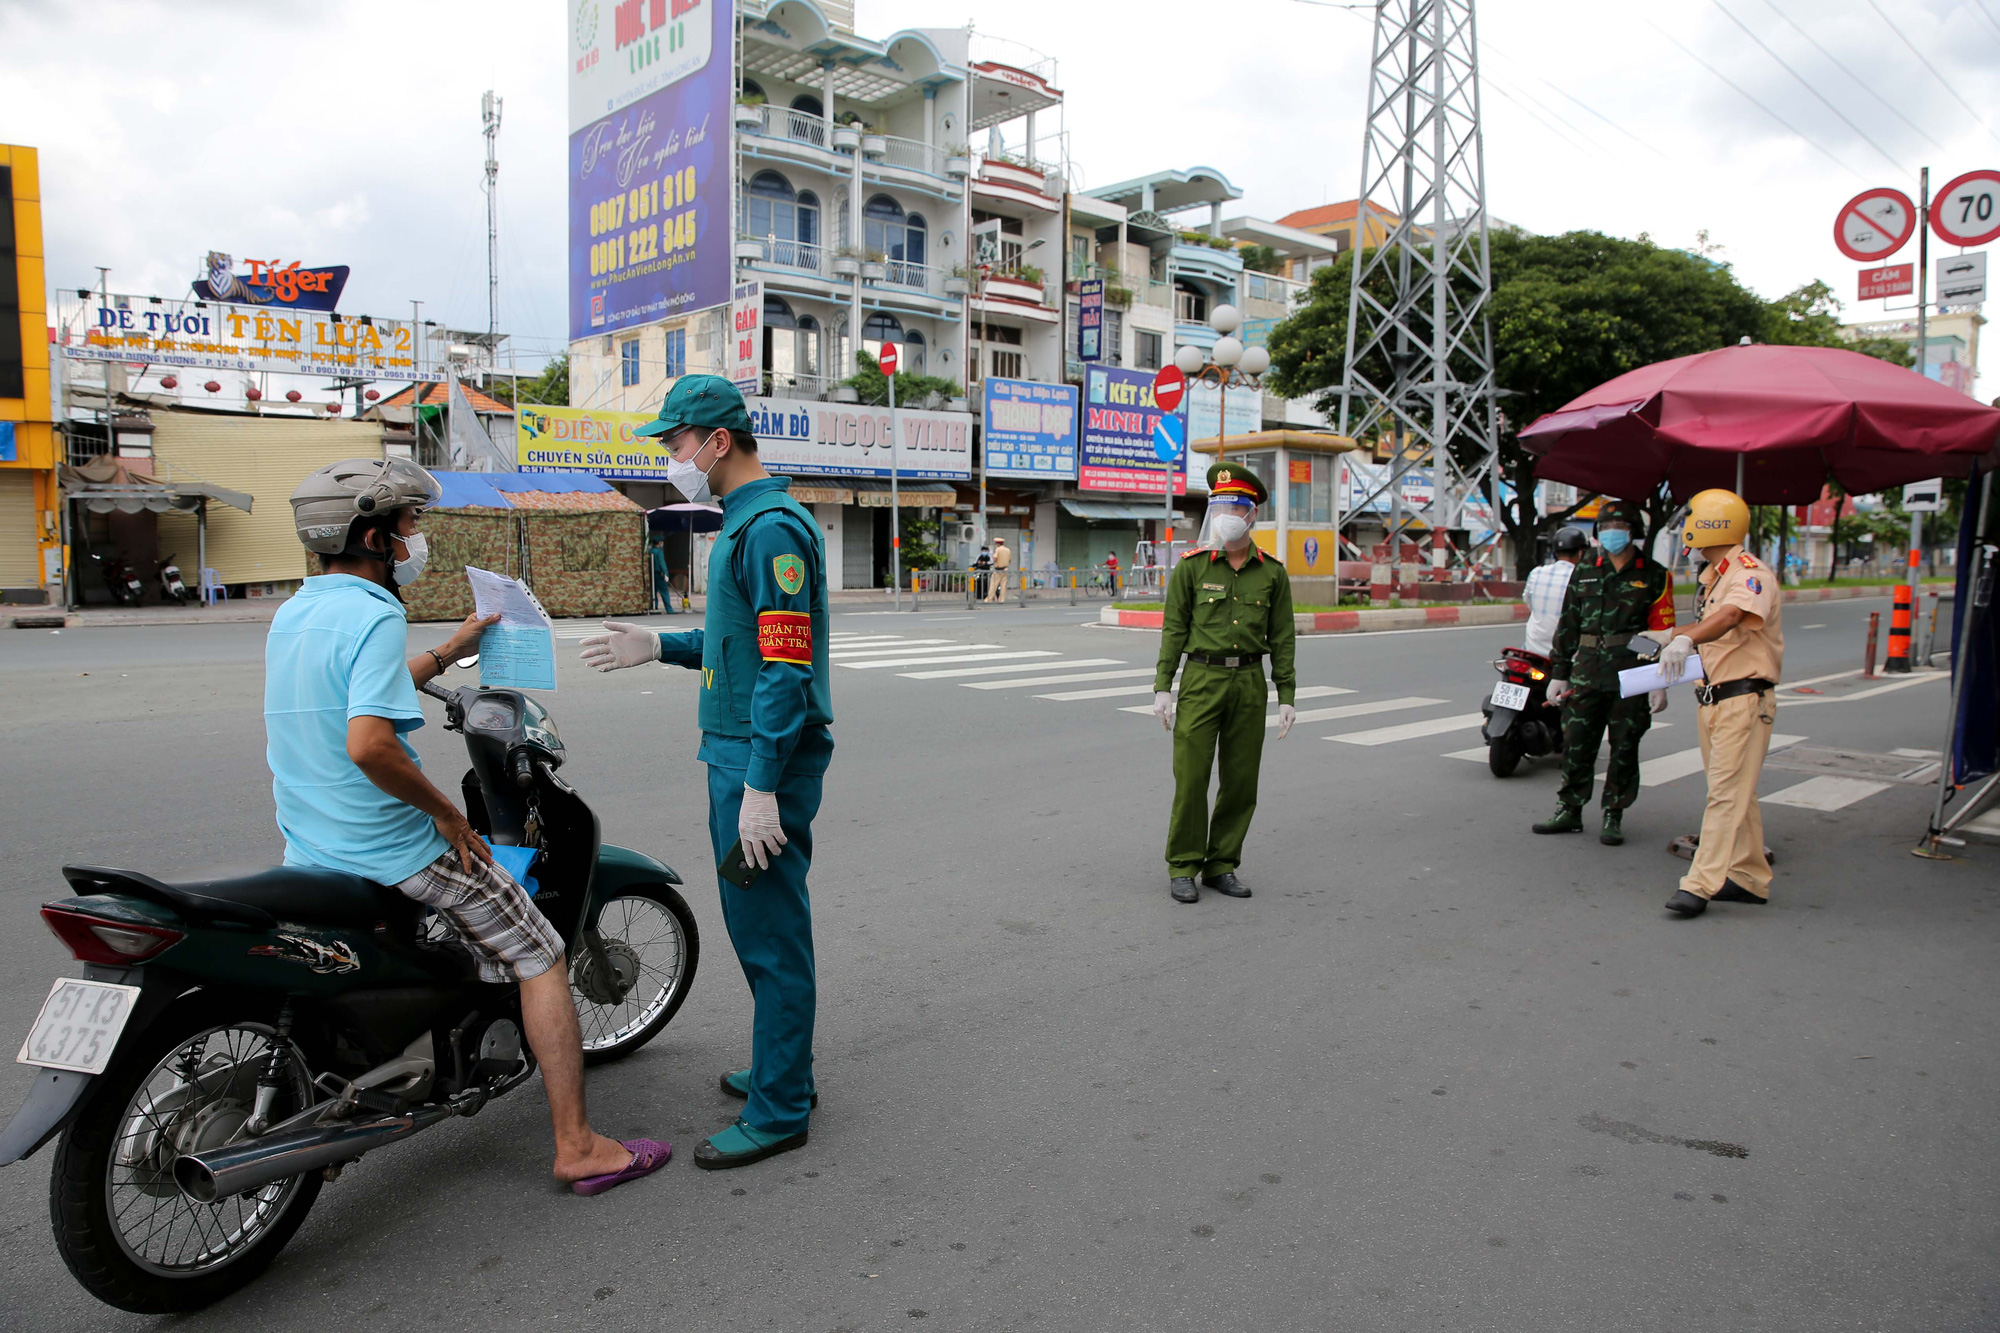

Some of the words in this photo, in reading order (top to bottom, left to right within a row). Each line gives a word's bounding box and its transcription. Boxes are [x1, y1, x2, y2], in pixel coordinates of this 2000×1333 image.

[590, 192, 626, 238] 0907
[628, 180, 658, 224] 951
[663, 165, 696, 211] 316
[1959, 192, 1993, 224] 70
[590, 234, 624, 278] 0961
[628, 223, 658, 266] 222
[663, 209, 696, 254] 345
[244, 258, 334, 302] Tiger
[590, 250, 696, 290] www.PhucAnVienLongAn.vn
[226, 310, 302, 342] TÊN
[395, 328, 412, 350] 2
[316, 366, 338, 374] 0903
[340, 367, 350, 376] 99
[352, 368, 364, 376] 28
[366, 368, 376, 377] 29
[406, 372, 417, 380] 89
[419, 372, 429, 380] 39
[432, 373, 442, 381] 39
[553, 414, 612, 447] ĐIỆN
[817, 411, 892, 456] NGỌC
[903, 418, 967, 452] VINH
[1088, 408, 1144, 434] MINH
[528, 449, 582, 464] CHUYÊN
[586, 448, 612, 465] SỬA
[616, 452, 651, 466] CHỮA
[1694, 520, 1732, 530] CSGT
[762, 622, 792, 636] QUÂN
[788, 638, 808, 648] TRA
[34, 1023, 108, 1064] 4375
